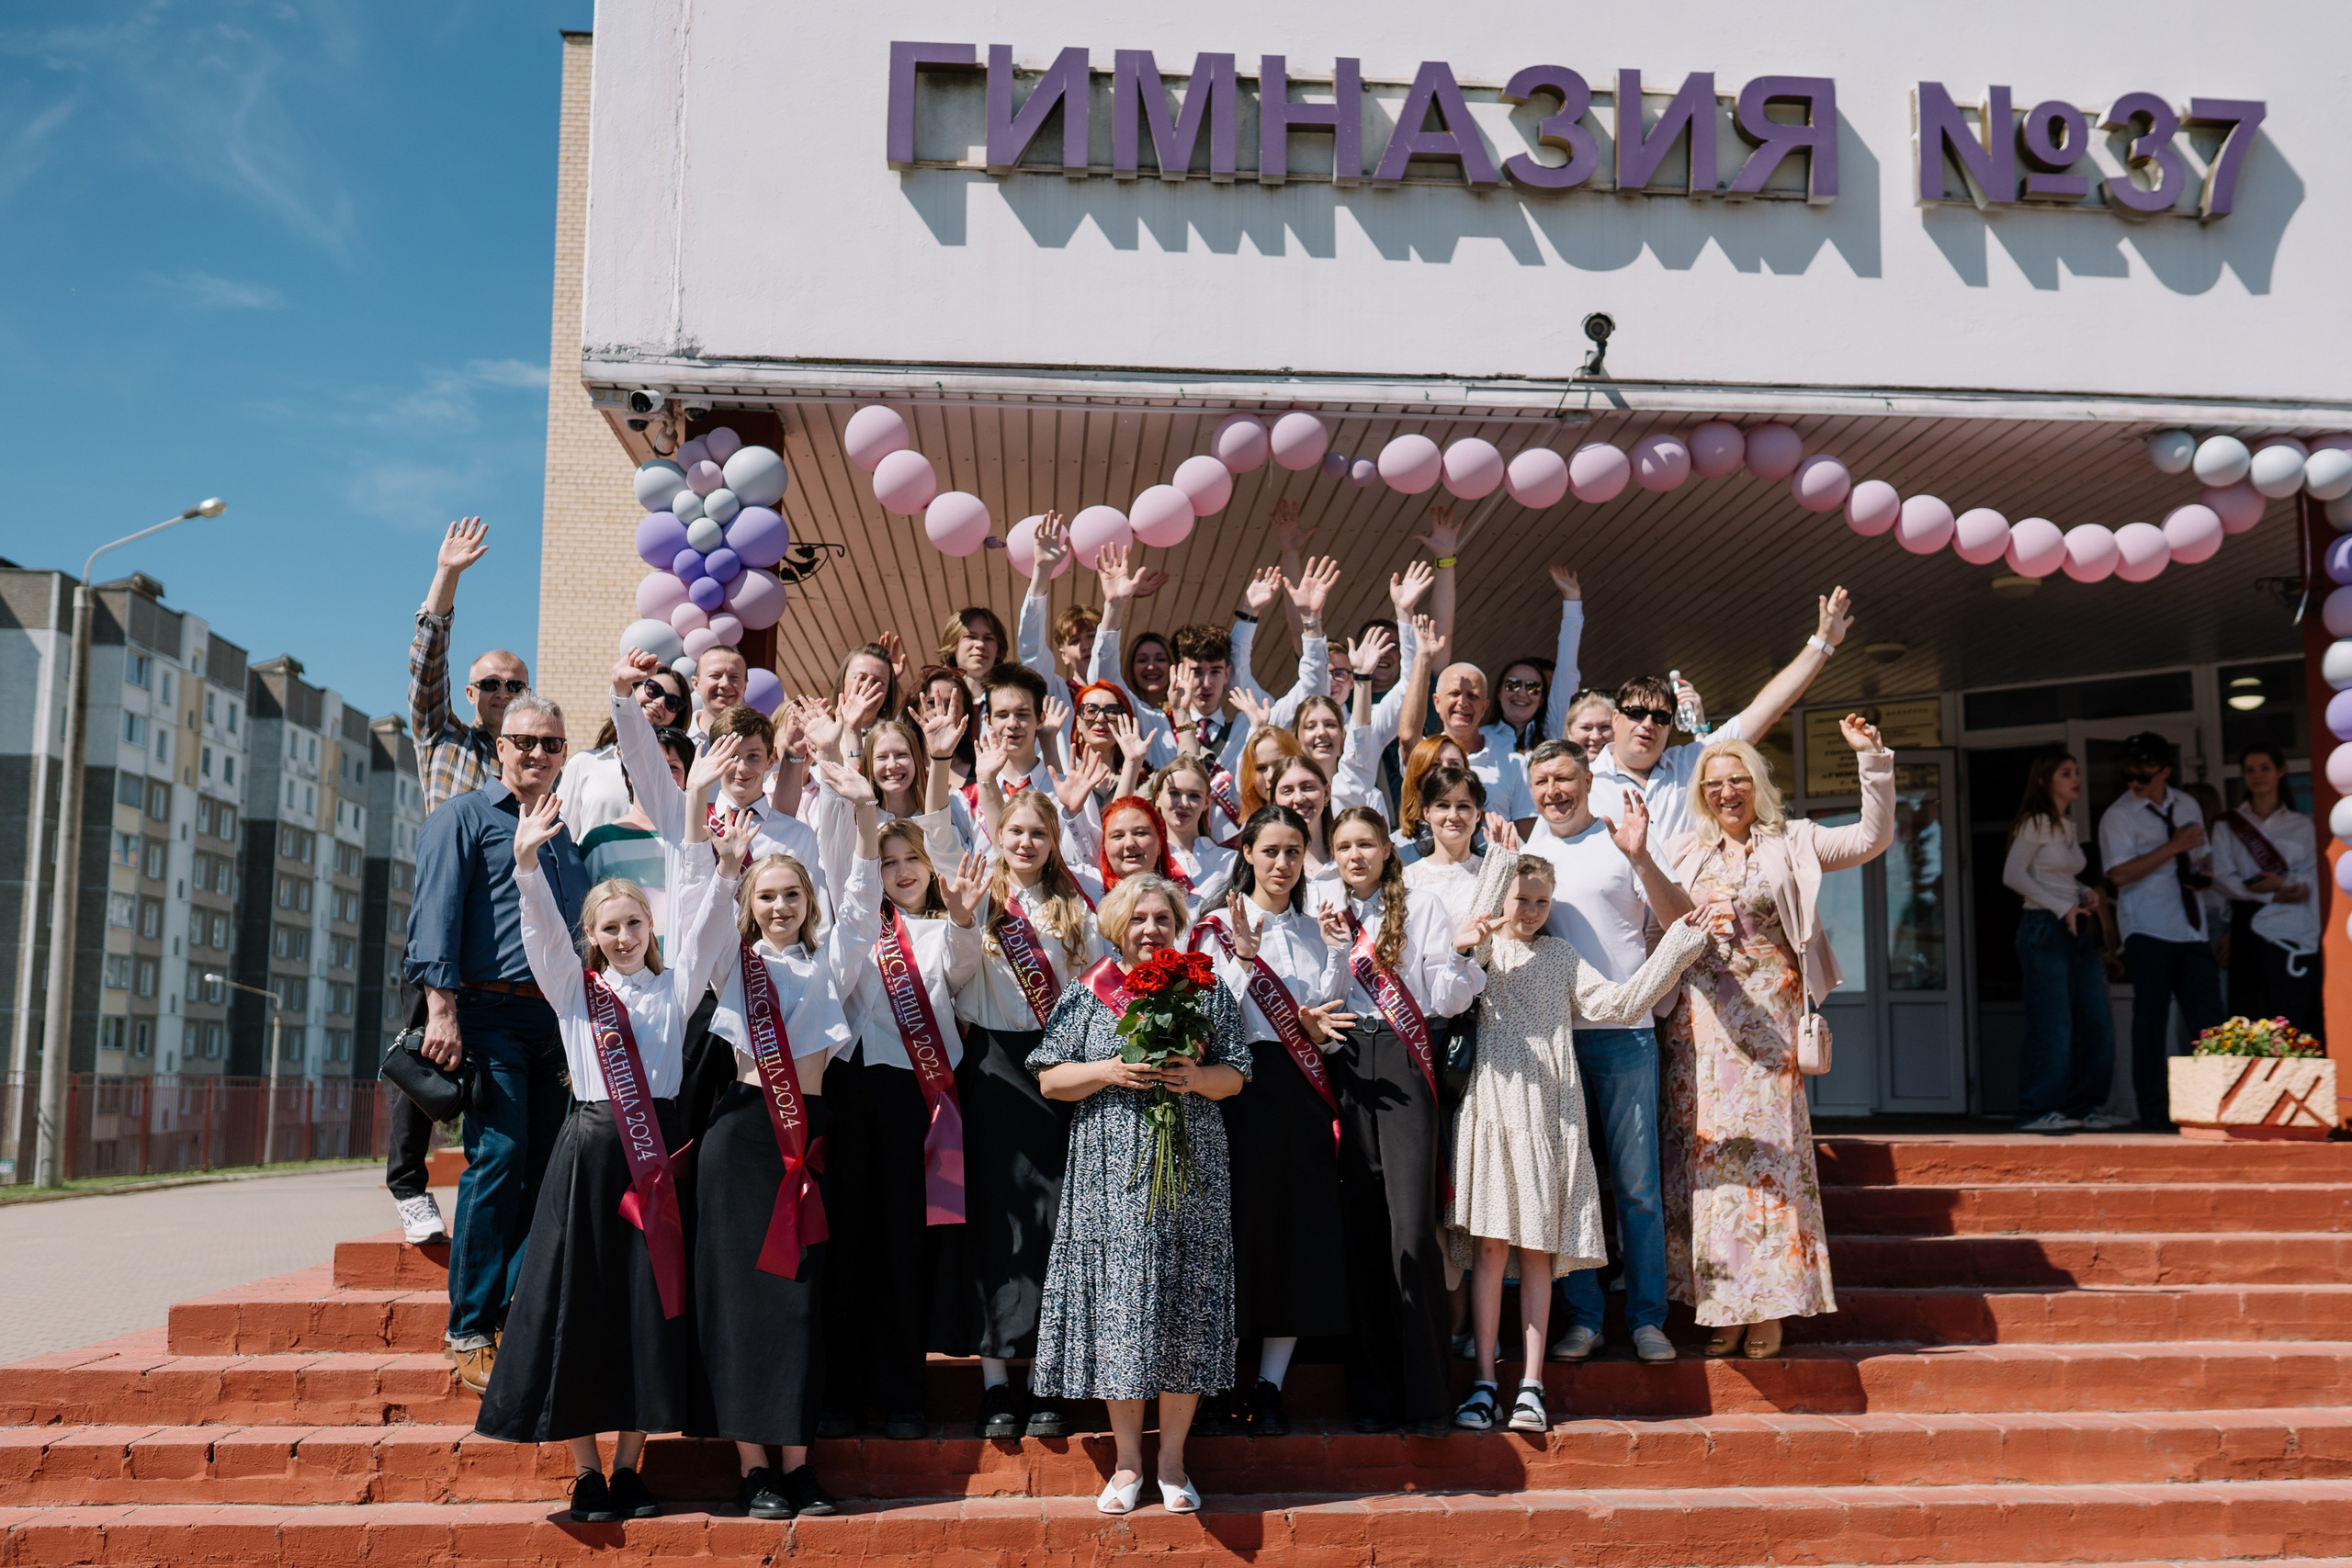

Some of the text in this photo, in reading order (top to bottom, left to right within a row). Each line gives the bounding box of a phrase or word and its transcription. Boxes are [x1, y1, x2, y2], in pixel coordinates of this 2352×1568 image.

[887, 41, 1838, 204] ГИМНАЗИЯ
[746, 983, 754, 1015] ГИМНАЗИЯ
[753, 1040, 764, 1067] МИНСКА
[880, 926, 943, 1081] ПУСКНИЦА 2024
[892, 998, 905, 1023] МИНСКА
[1270, 1015, 1286, 1038] МИНСКА
[593, 1017, 604, 1049] ГИМНАЗИЯ
[606, 1073, 618, 1100] МИНСКА
[1297, 1043, 1328, 1086] 2024
[772, 1079, 801, 1131] 2024
[626, 1111, 657, 1162] 2024
